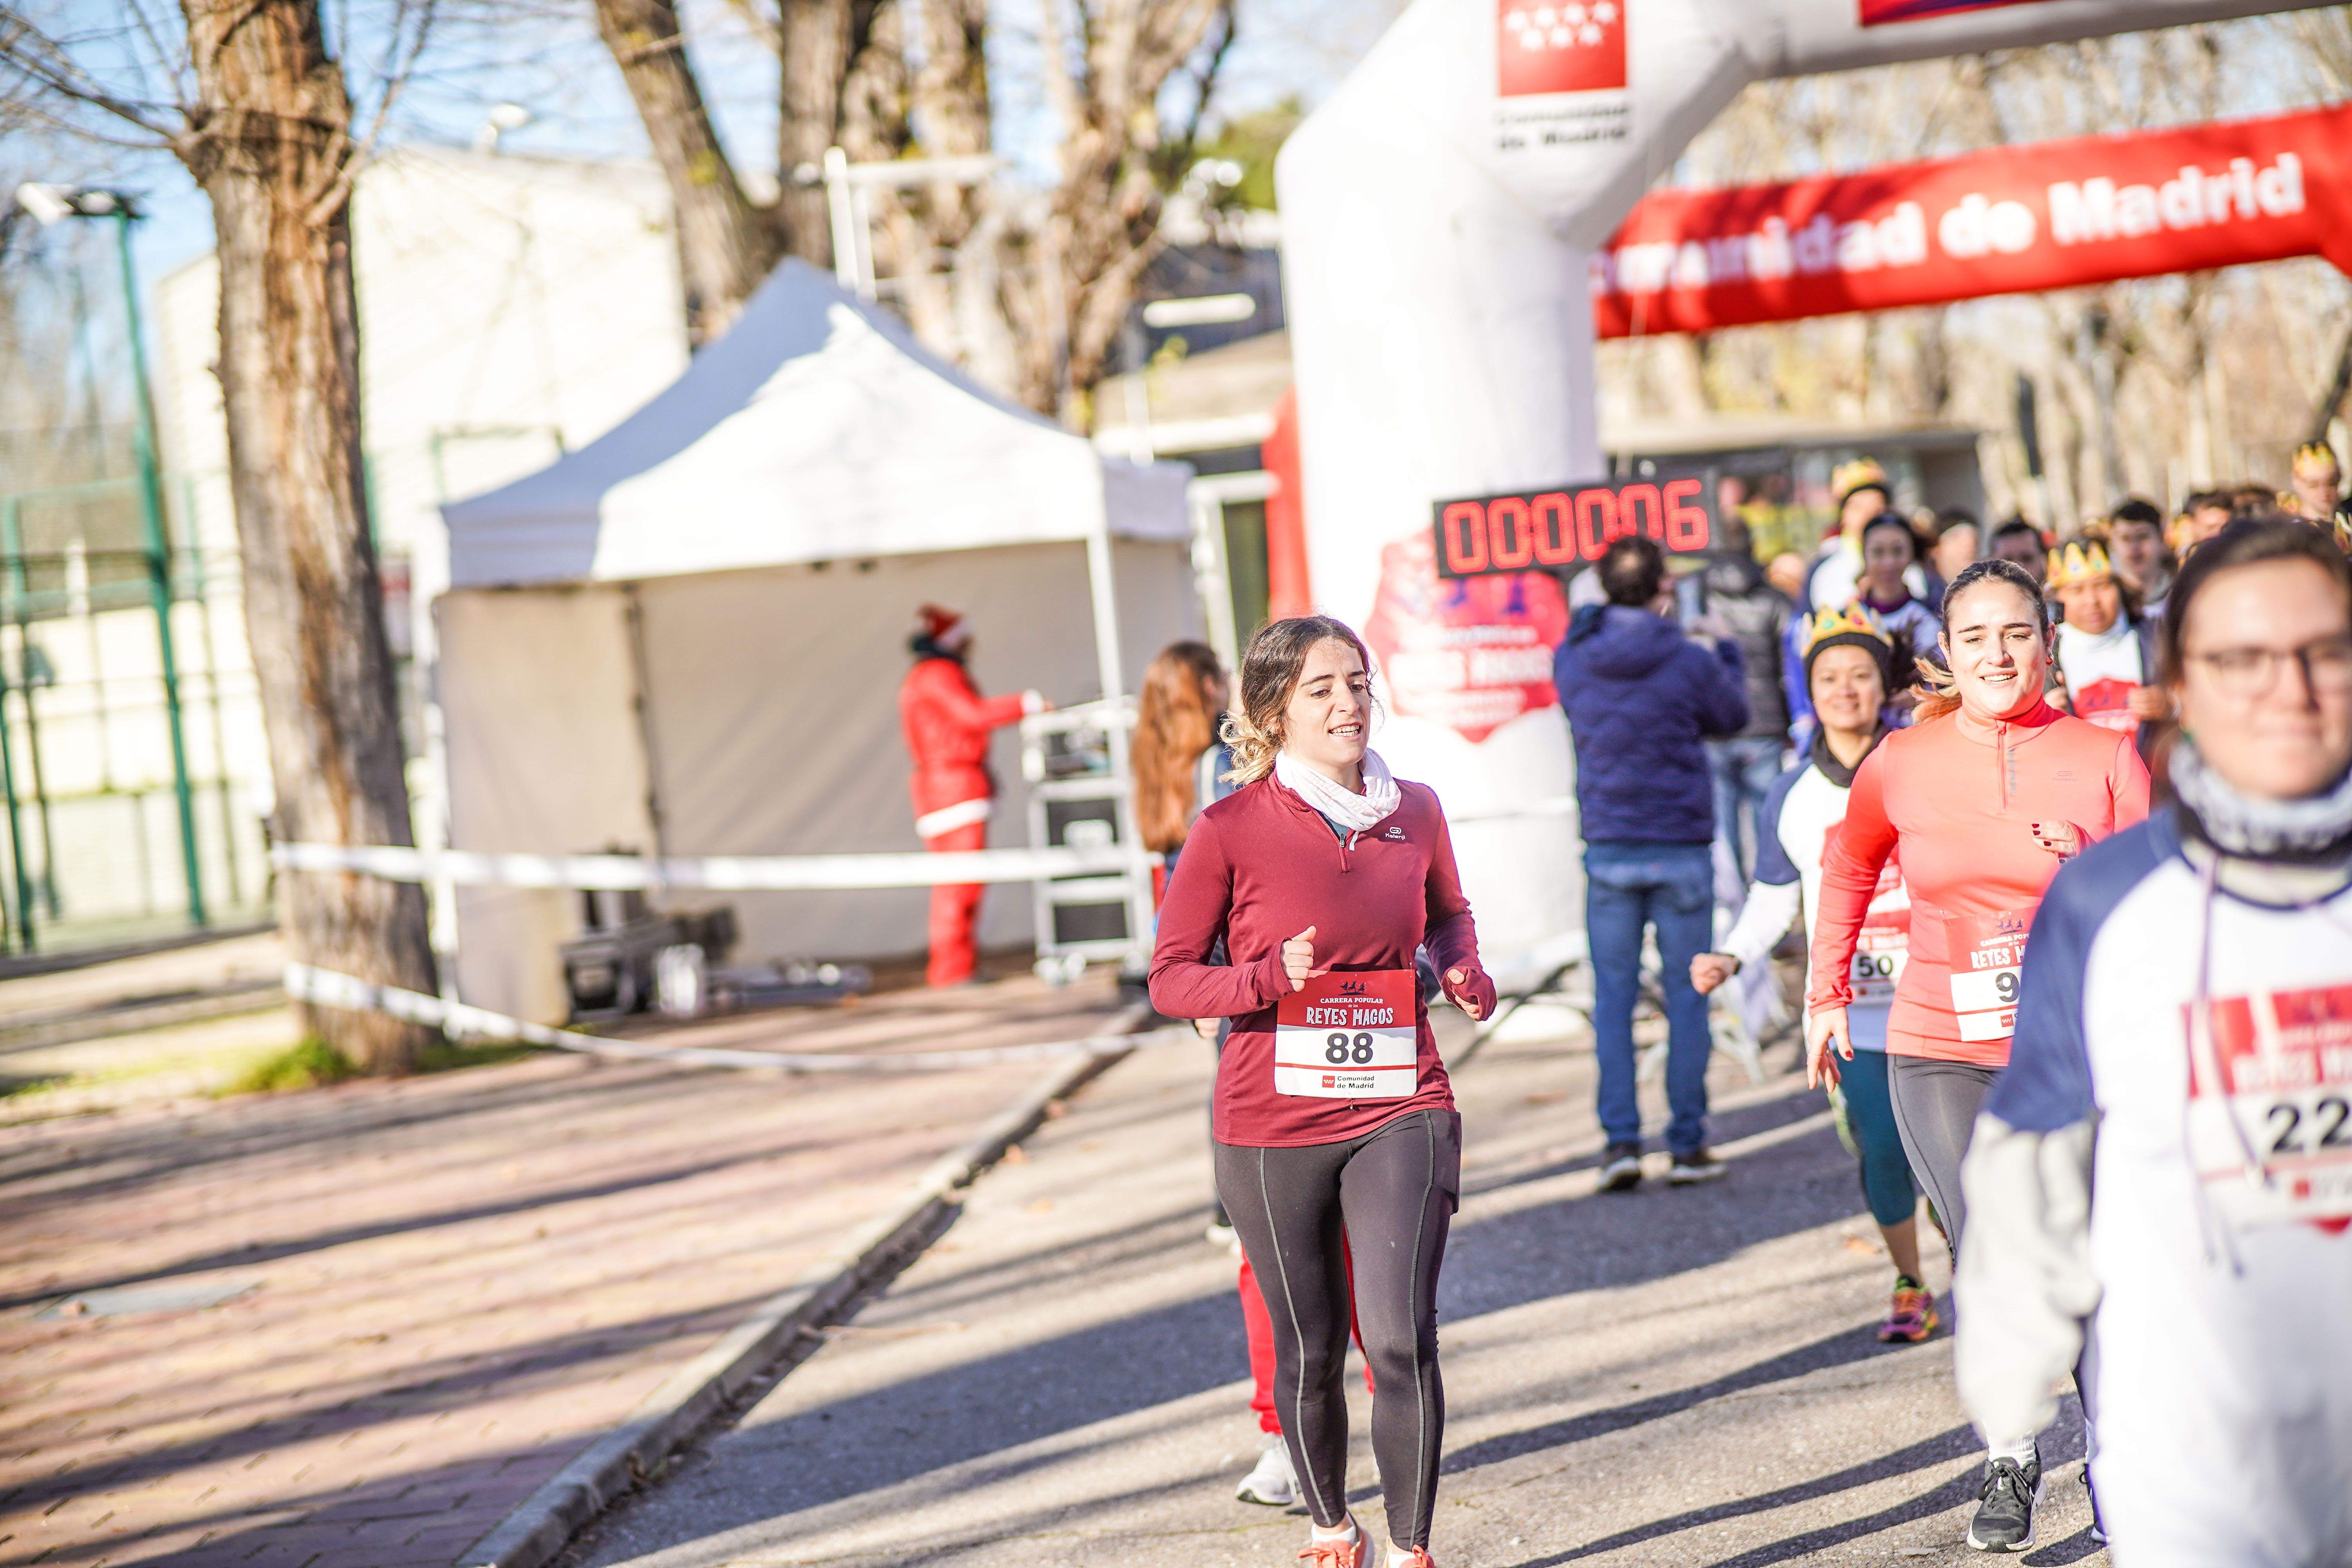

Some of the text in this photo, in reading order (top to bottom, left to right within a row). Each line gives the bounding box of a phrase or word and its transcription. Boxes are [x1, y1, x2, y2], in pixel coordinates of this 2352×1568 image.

[1588, 152, 2306, 294] omunidad de Madrid
[1858, 956, 1893, 977] 50
[1970, 945, 2025, 969] REYES M
[1306, 1007, 1394, 1026] REYES MAGOS
[1325, 1033, 1373, 1064] 88
